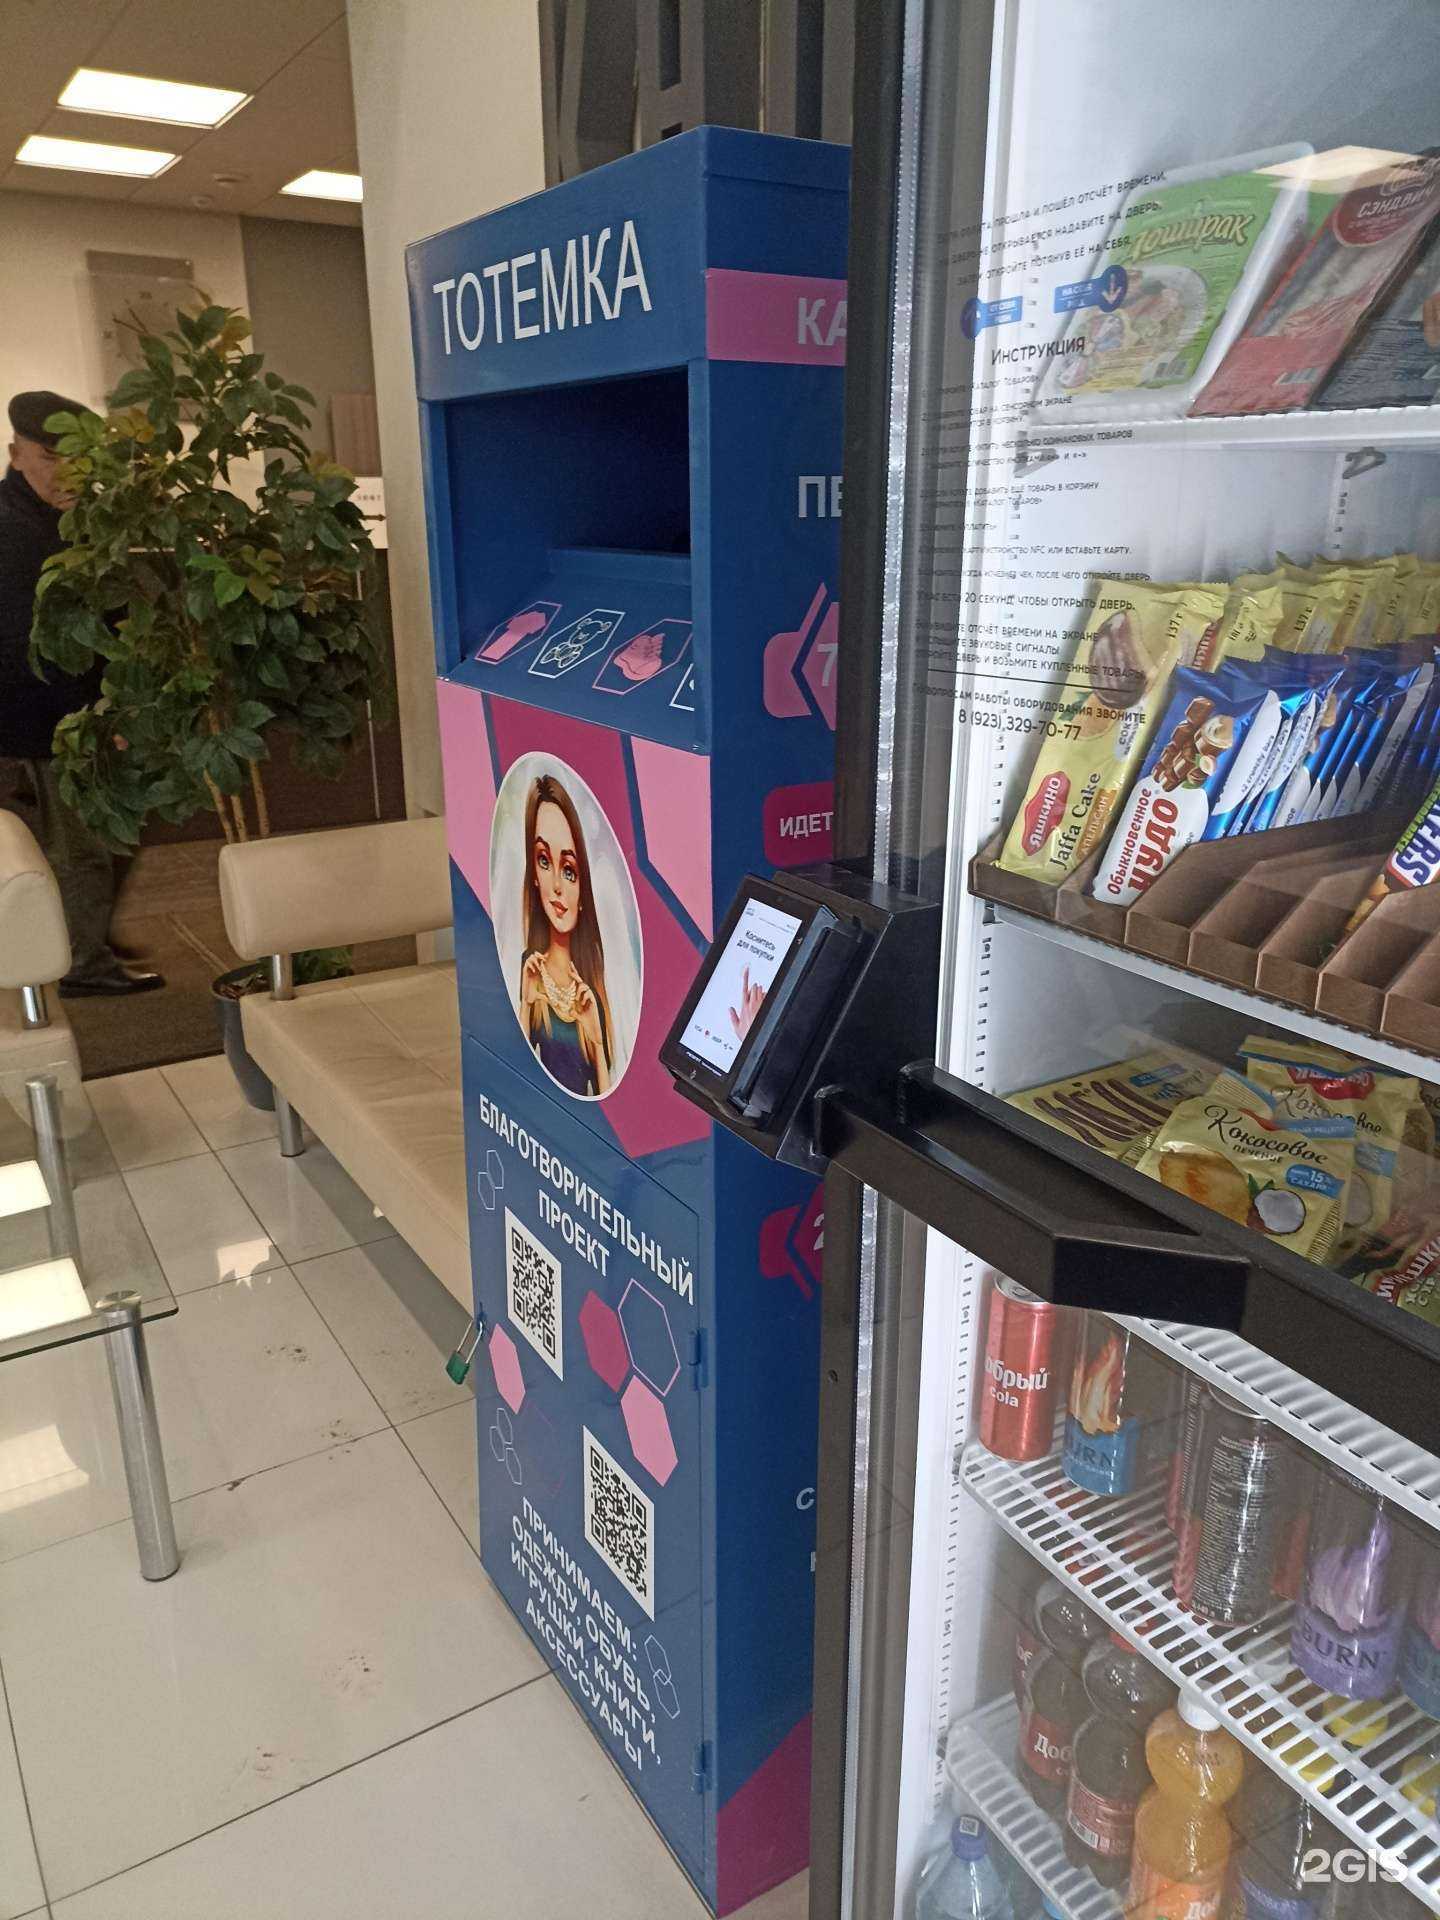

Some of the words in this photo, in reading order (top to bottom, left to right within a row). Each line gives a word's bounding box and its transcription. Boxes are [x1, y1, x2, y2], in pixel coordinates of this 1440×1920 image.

[1055, 214, 1105, 237] НАДАВИТЕ
[433, 219, 653, 355] ТОТЕМКА
[991, 336, 1086, 366] ИНСТРУКЦИЯ
[964, 591, 977, 604] 20
[1018, 594, 1049, 607] ЧТОБЫ
[1051, 596, 1097, 609] ОТКРЫТЬ
[1099, 598, 1137, 611] ДВЕРЬ.
[1002, 626, 1043, 638] ВРЕМЕНИ
[1045, 629, 1058, 639] НА
[1062, 630, 1099, 642] ЭКРАНЕ
[1015, 643, 1060, 656] СИГНАЛЫ
[993, 656, 1038, 669] ВОЗЬМИТЕ
[1040, 660, 1098, 676] КУПЛЕННЫЕ
[958, 708, 967, 723] 8
[970, 711, 1003, 730] (923)
[1006, 715, 1082, 741] 329-70-77
[974, 692, 1011, 706] РАБОТЫ
[1013, 697, 1093, 718] ОБОРУДОВАНИЯ
[1095, 708, 1147, 725] ЗВОНИТЕ
[779, 811, 833, 840] ИДЕТ
[1050, 823, 1083, 871] Jaffa
[1071, 772, 1102, 820] Cake
[1106, 788, 1153, 896] Обыкновенное
[1204, 1104, 1329, 1165] Кокосовое
[479, 1094, 695, 1306] БЛАГОТВОРИТЕЛЬНЫЙ
[538, 1189, 610, 1277] ПРОЕКТ
[522, 1496, 638, 1661] ПРИНИМАЕМ:
[511, 1514, 581, 1626] ОДЕЖДУ,
[585, 1613, 657, 1723] ОБУВЬ,
[1301, 1618, 1381, 1670] BURN
[510, 1541, 590, 1669] ИГРУШКИ,
[594, 1659, 662, 1766] КНИГИ,
[525, 1597, 644, 1771] АКСЕССУАРЫ
